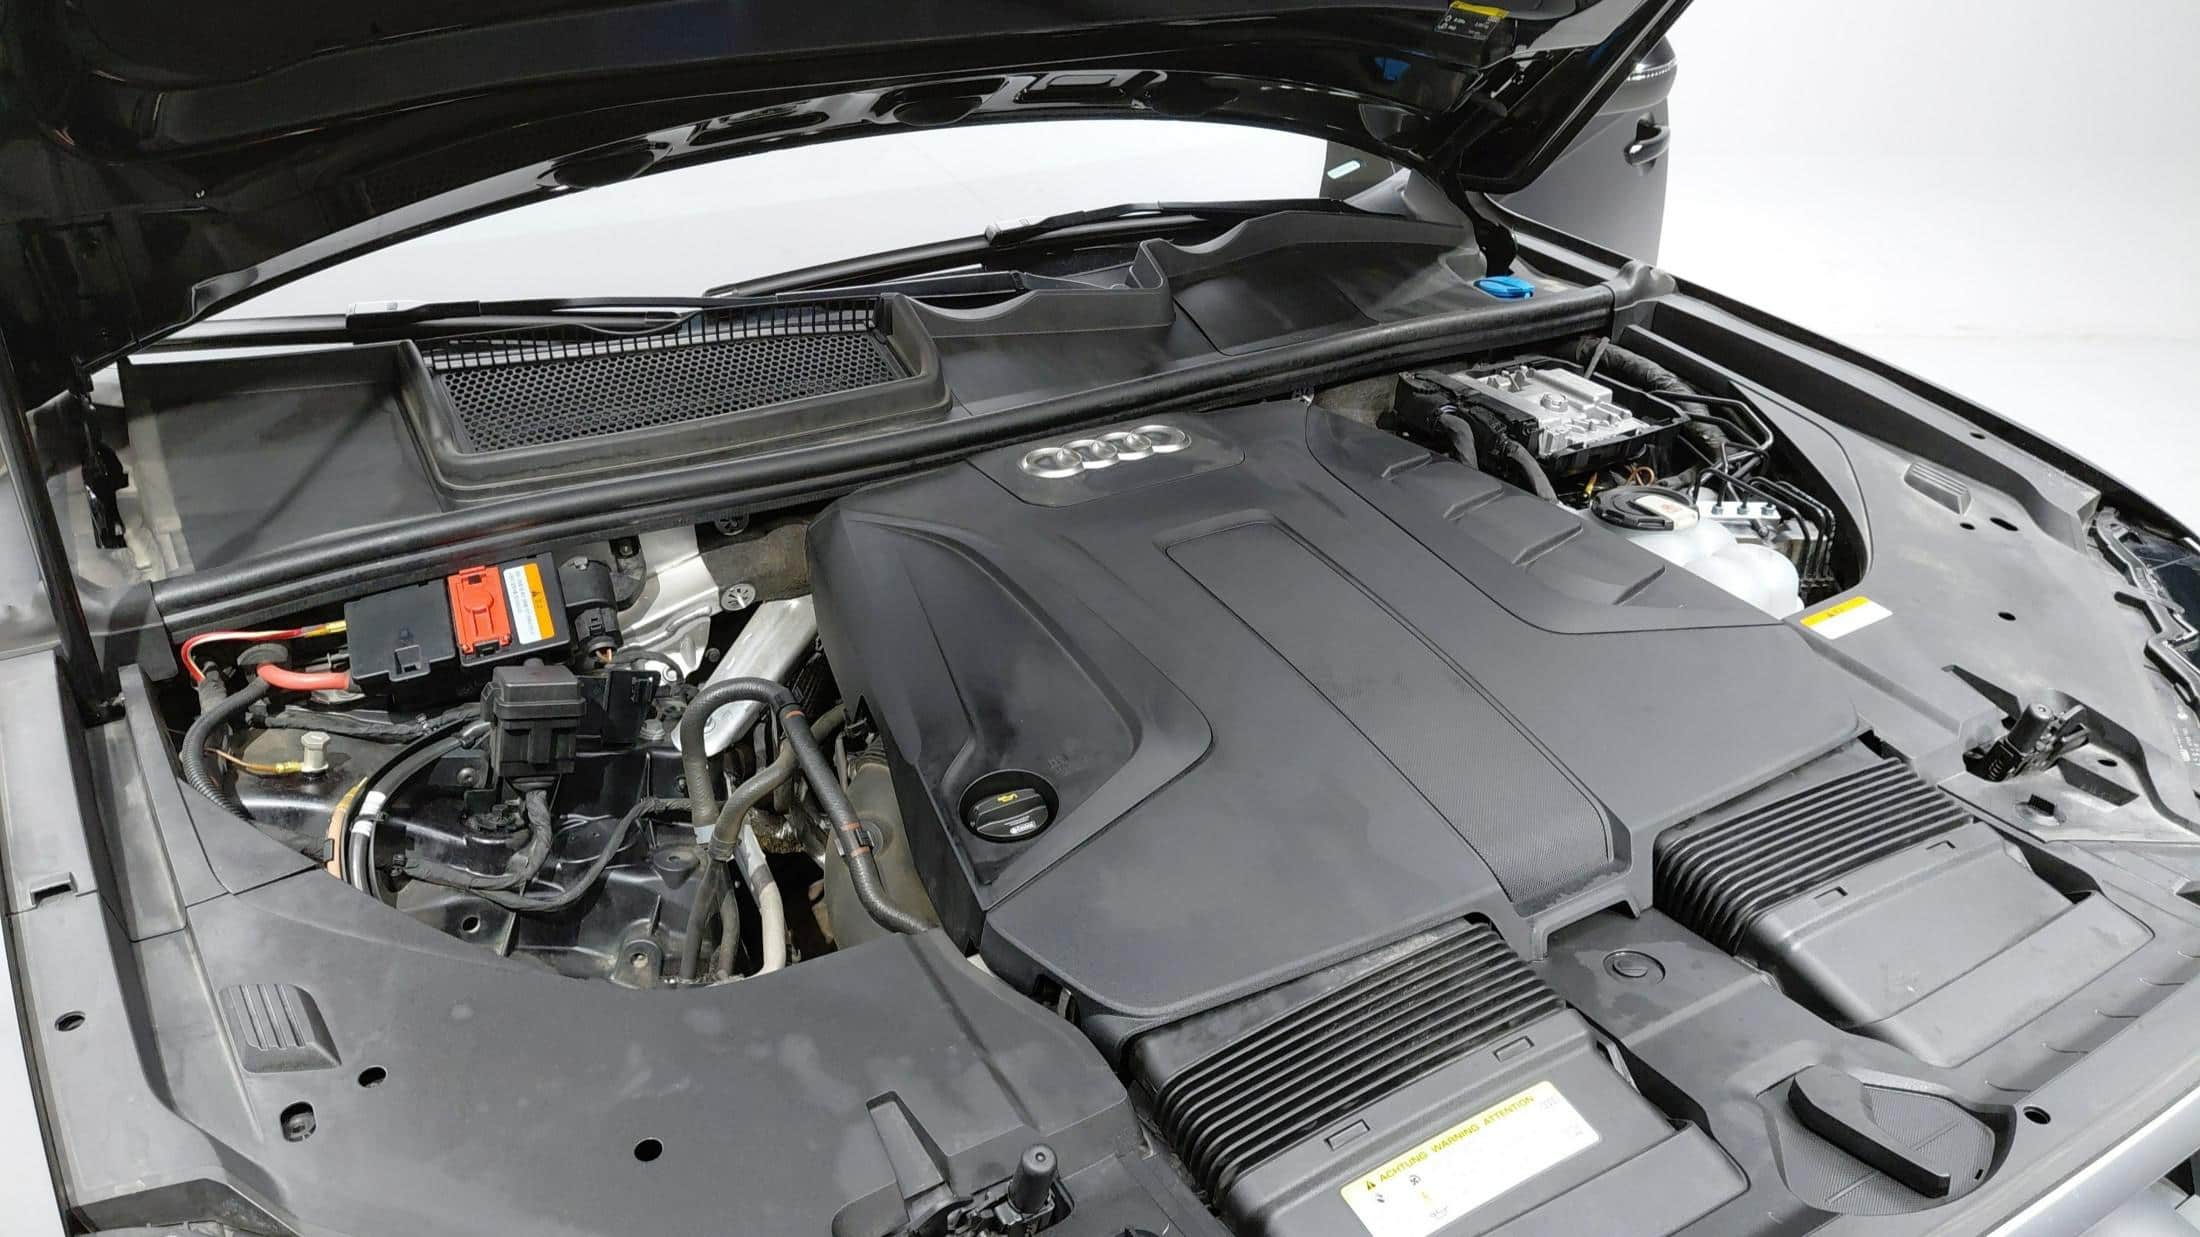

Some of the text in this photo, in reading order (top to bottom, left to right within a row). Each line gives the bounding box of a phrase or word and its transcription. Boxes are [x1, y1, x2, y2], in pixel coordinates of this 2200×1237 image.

[1380, 1151, 1428, 1182] ACHTUNG
[1432, 1124, 1479, 1152] WARNING
[1484, 1096, 1534, 1125] ATTENTION
